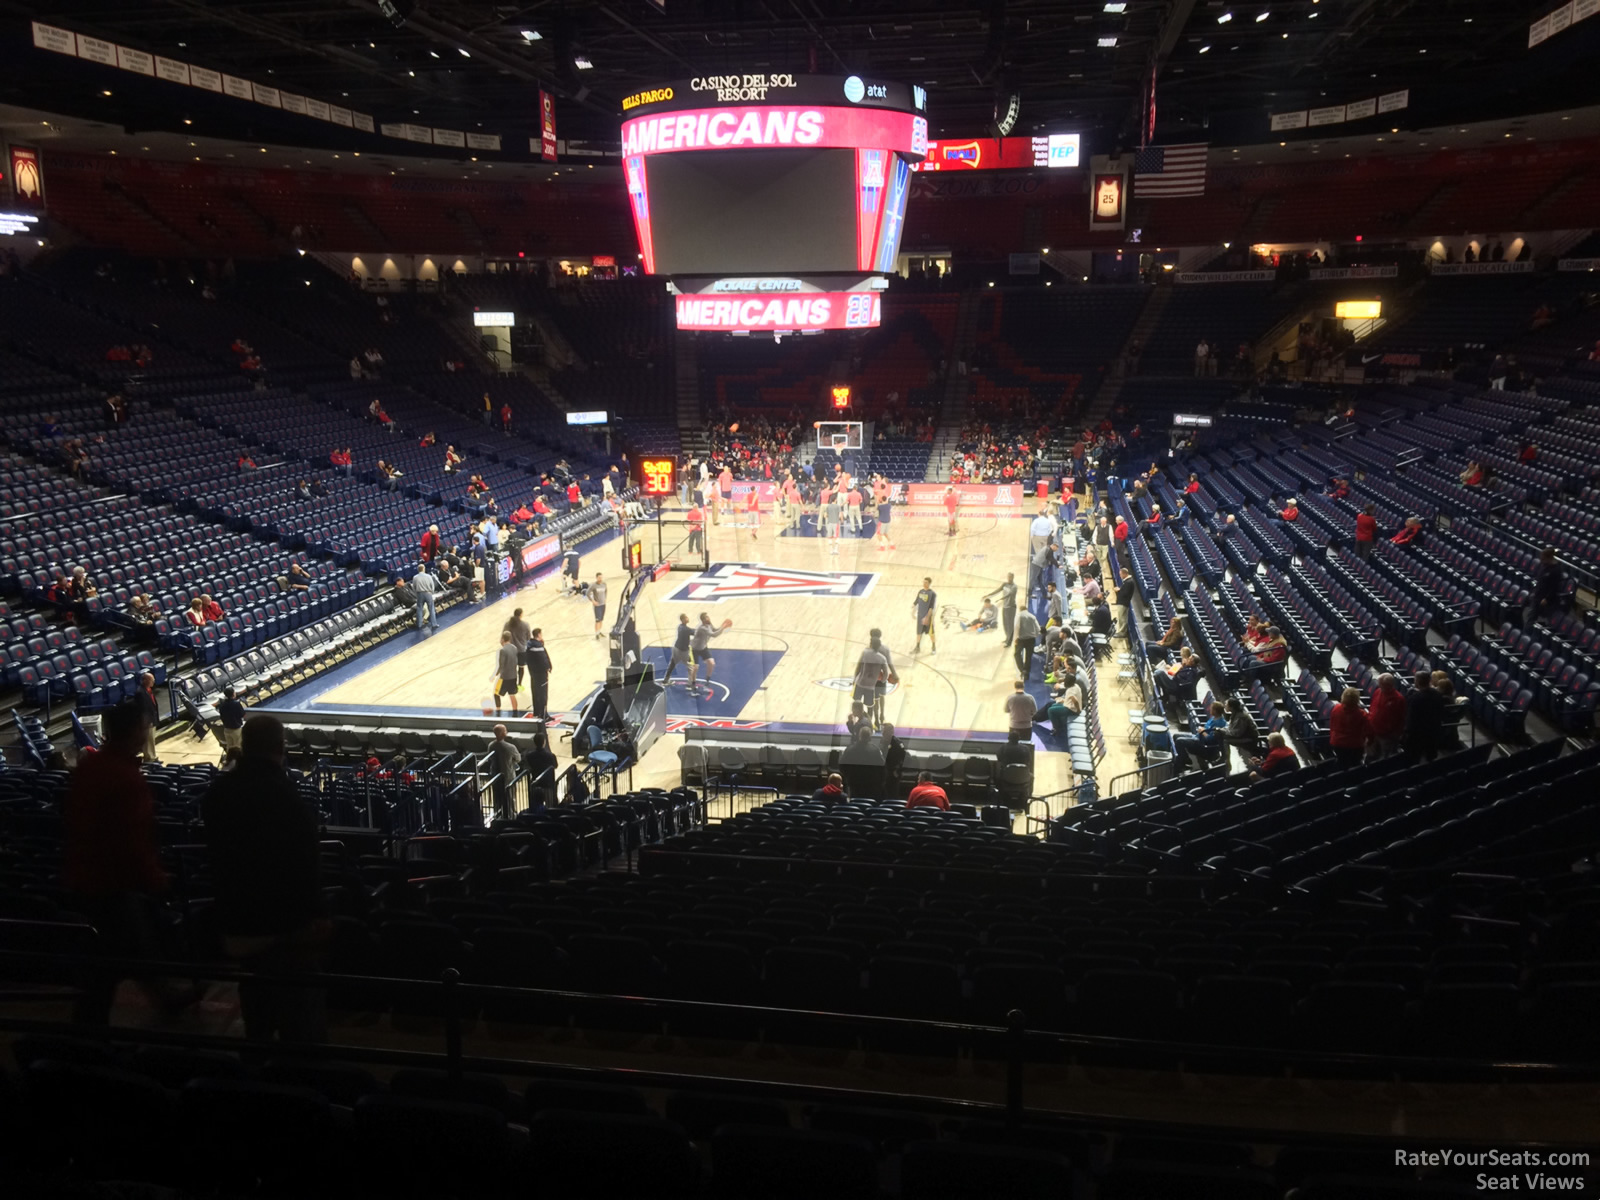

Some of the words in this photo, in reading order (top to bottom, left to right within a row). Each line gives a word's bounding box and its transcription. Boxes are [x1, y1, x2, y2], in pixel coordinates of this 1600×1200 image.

[690, 75, 740, 91] CASINO
[743, 74, 769, 88] DEL
[770, 74, 797, 88] SOL
[641, 88, 673, 104] FARGO
[717, 87, 768, 101] RESORT
[867, 84, 887, 98] at&t
[621, 111, 824, 158] -AMERICANS
[1051, 146, 1074, 158] TEP
[1103, 194, 1114, 204] 25
[1503, 262, 1525, 271] CLUB
[713, 280, 756, 291] MCKALE
[758, 280, 802, 291] CENTER
[846, 295, 871, 327] 28
[648, 474, 669, 492] 30
[524, 538, 560, 564] AMERICANS
